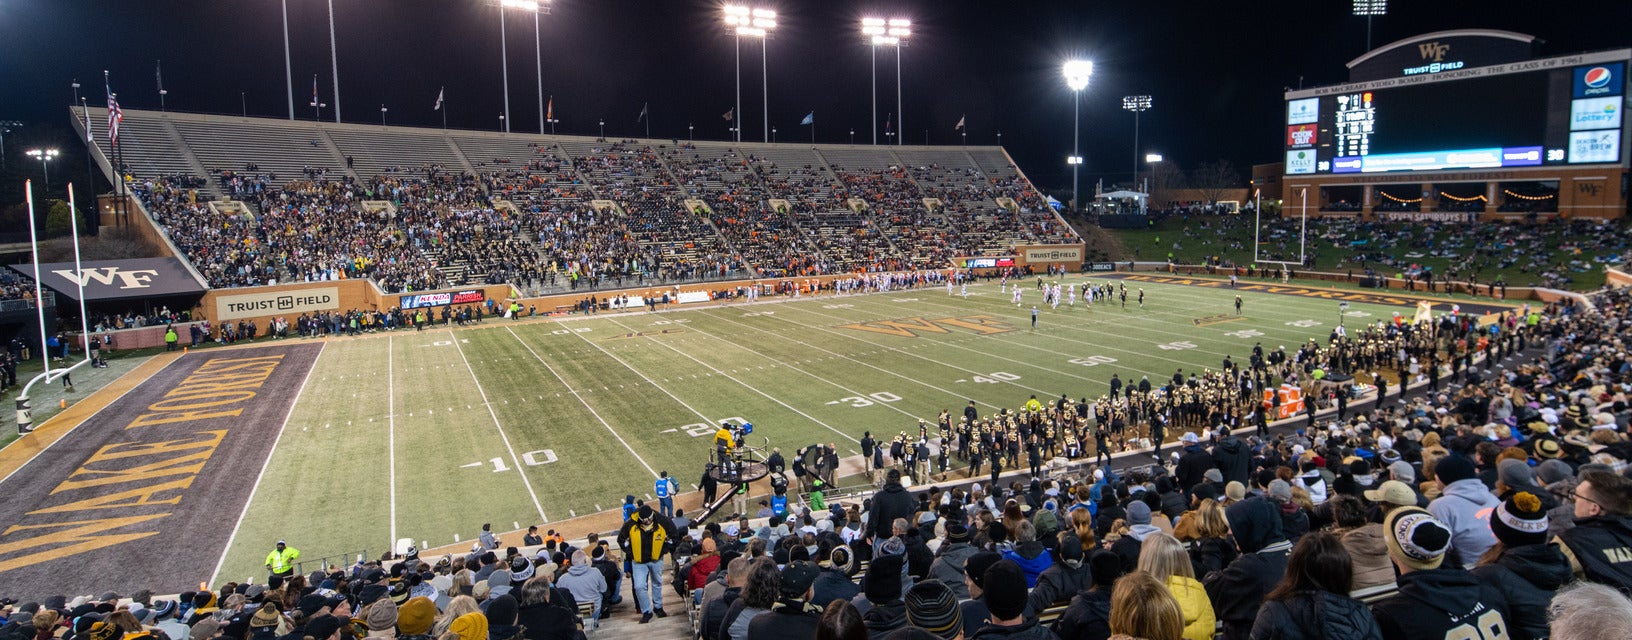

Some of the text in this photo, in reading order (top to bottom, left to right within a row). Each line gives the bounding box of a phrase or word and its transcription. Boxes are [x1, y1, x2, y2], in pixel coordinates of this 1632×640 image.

[1418, 41, 1450, 62] WF
[1331, 83, 1368, 93] McCREARY
[1371, 79, 1396, 88] VIDEO
[1399, 76, 1427, 85] BOARD
[1432, 70, 1481, 80] HONORING
[1510, 63, 1540, 72] CLASS
[1543, 59, 1557, 67] OF
[1561, 56, 1584, 65] 1961
[1403, 61, 1464, 75] TRUIST FIELD
[1575, 113, 1614, 123] Lottery
[1292, 130, 1313, 138] COOK
[1295, 137, 1311, 145] OUT
[52, 266, 159, 290] WF
[228, 294, 331, 312] TRUIST FIELD
[420, 293, 450, 302] KENDA
[1068, 355, 1118, 367] 50
[972, 371, 1021, 384] 40
[839, 391, 903, 408] 30
[1281, 406, 1289, 416] G
[1065, 436, 1077, 446] 85
[0, 354, 285, 573] WAKE FOREST
[487, 449, 558, 473] 10
